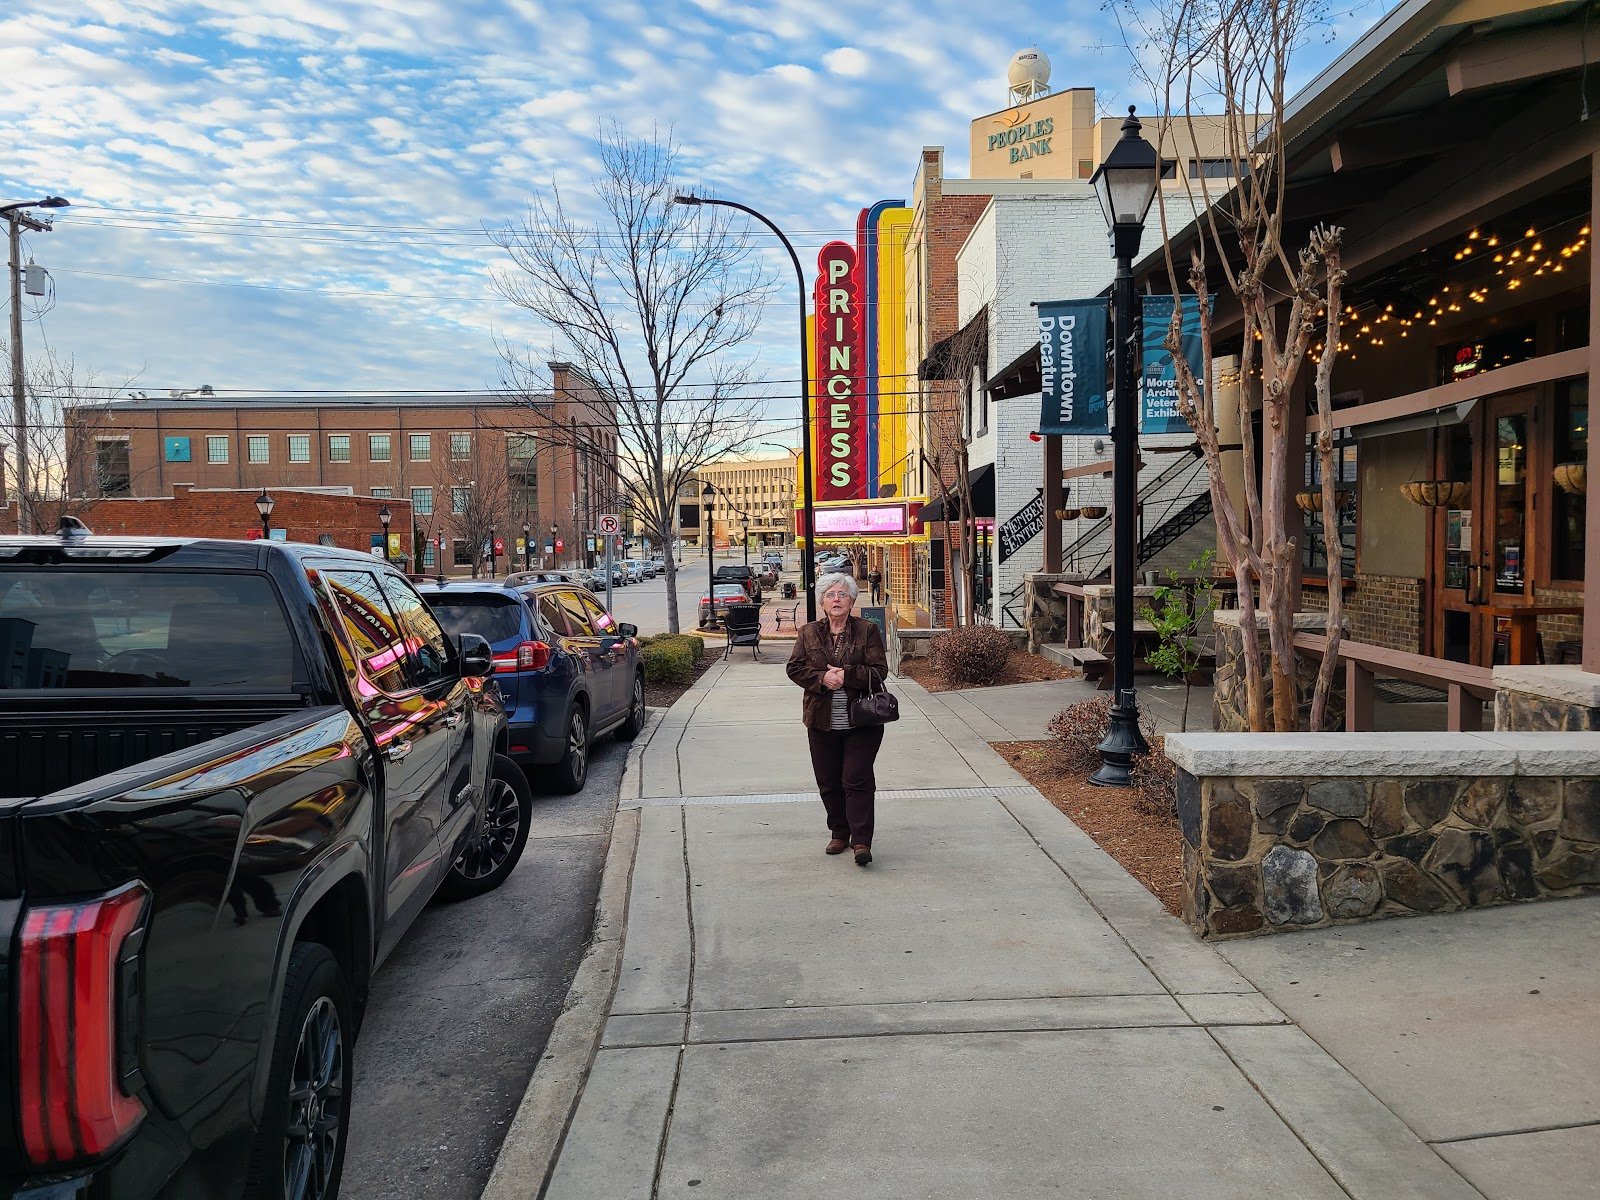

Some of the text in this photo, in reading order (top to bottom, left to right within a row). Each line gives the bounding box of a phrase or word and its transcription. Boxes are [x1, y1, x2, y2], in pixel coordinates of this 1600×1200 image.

[988, 117, 1053, 151] PEOPLES
[1009, 137, 1052, 164] BANK
[827, 259, 852, 487] PRINCESS
[1039, 316, 1057, 396] Decatur
[1058, 315, 1077, 422] Downtown
[1146, 378, 1178, 388] Morg
[1146, 399, 1194, 408] Veteras
[1000, 494, 1044, 541] MEMBER
